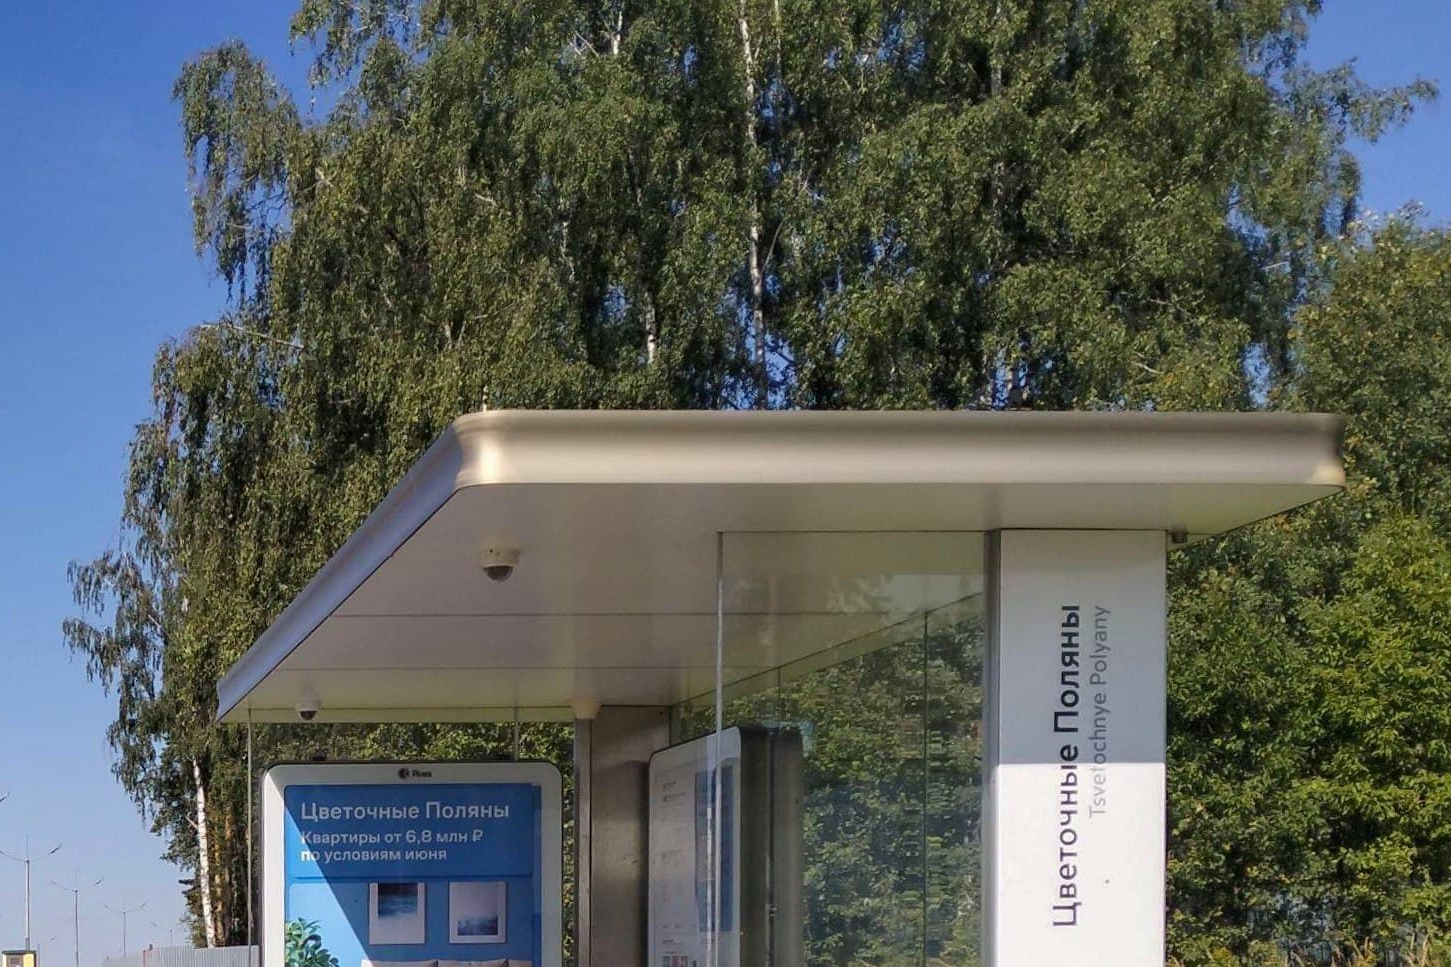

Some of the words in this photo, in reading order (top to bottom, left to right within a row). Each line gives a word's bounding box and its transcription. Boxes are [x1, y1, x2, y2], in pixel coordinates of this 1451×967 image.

[1053, 605, 1080, 733] Поляны
[1089, 605, 1111, 685] Polyany
[1088, 692, 1111, 818] Tsvetochnye
[301, 802, 420, 823] Цветочные
[425, 801, 510, 819] Поляны
[301, 831, 381, 847] Квартиры
[384, 832, 402, 843] от
[405, 829, 432, 845] 6,8
[436, 832, 468, 843] млн
[1052, 743, 1082, 927] Цветочные
[301, 851, 320, 862] по
[324, 850, 401, 864] условиям
[405, 849, 447, 861] июня
